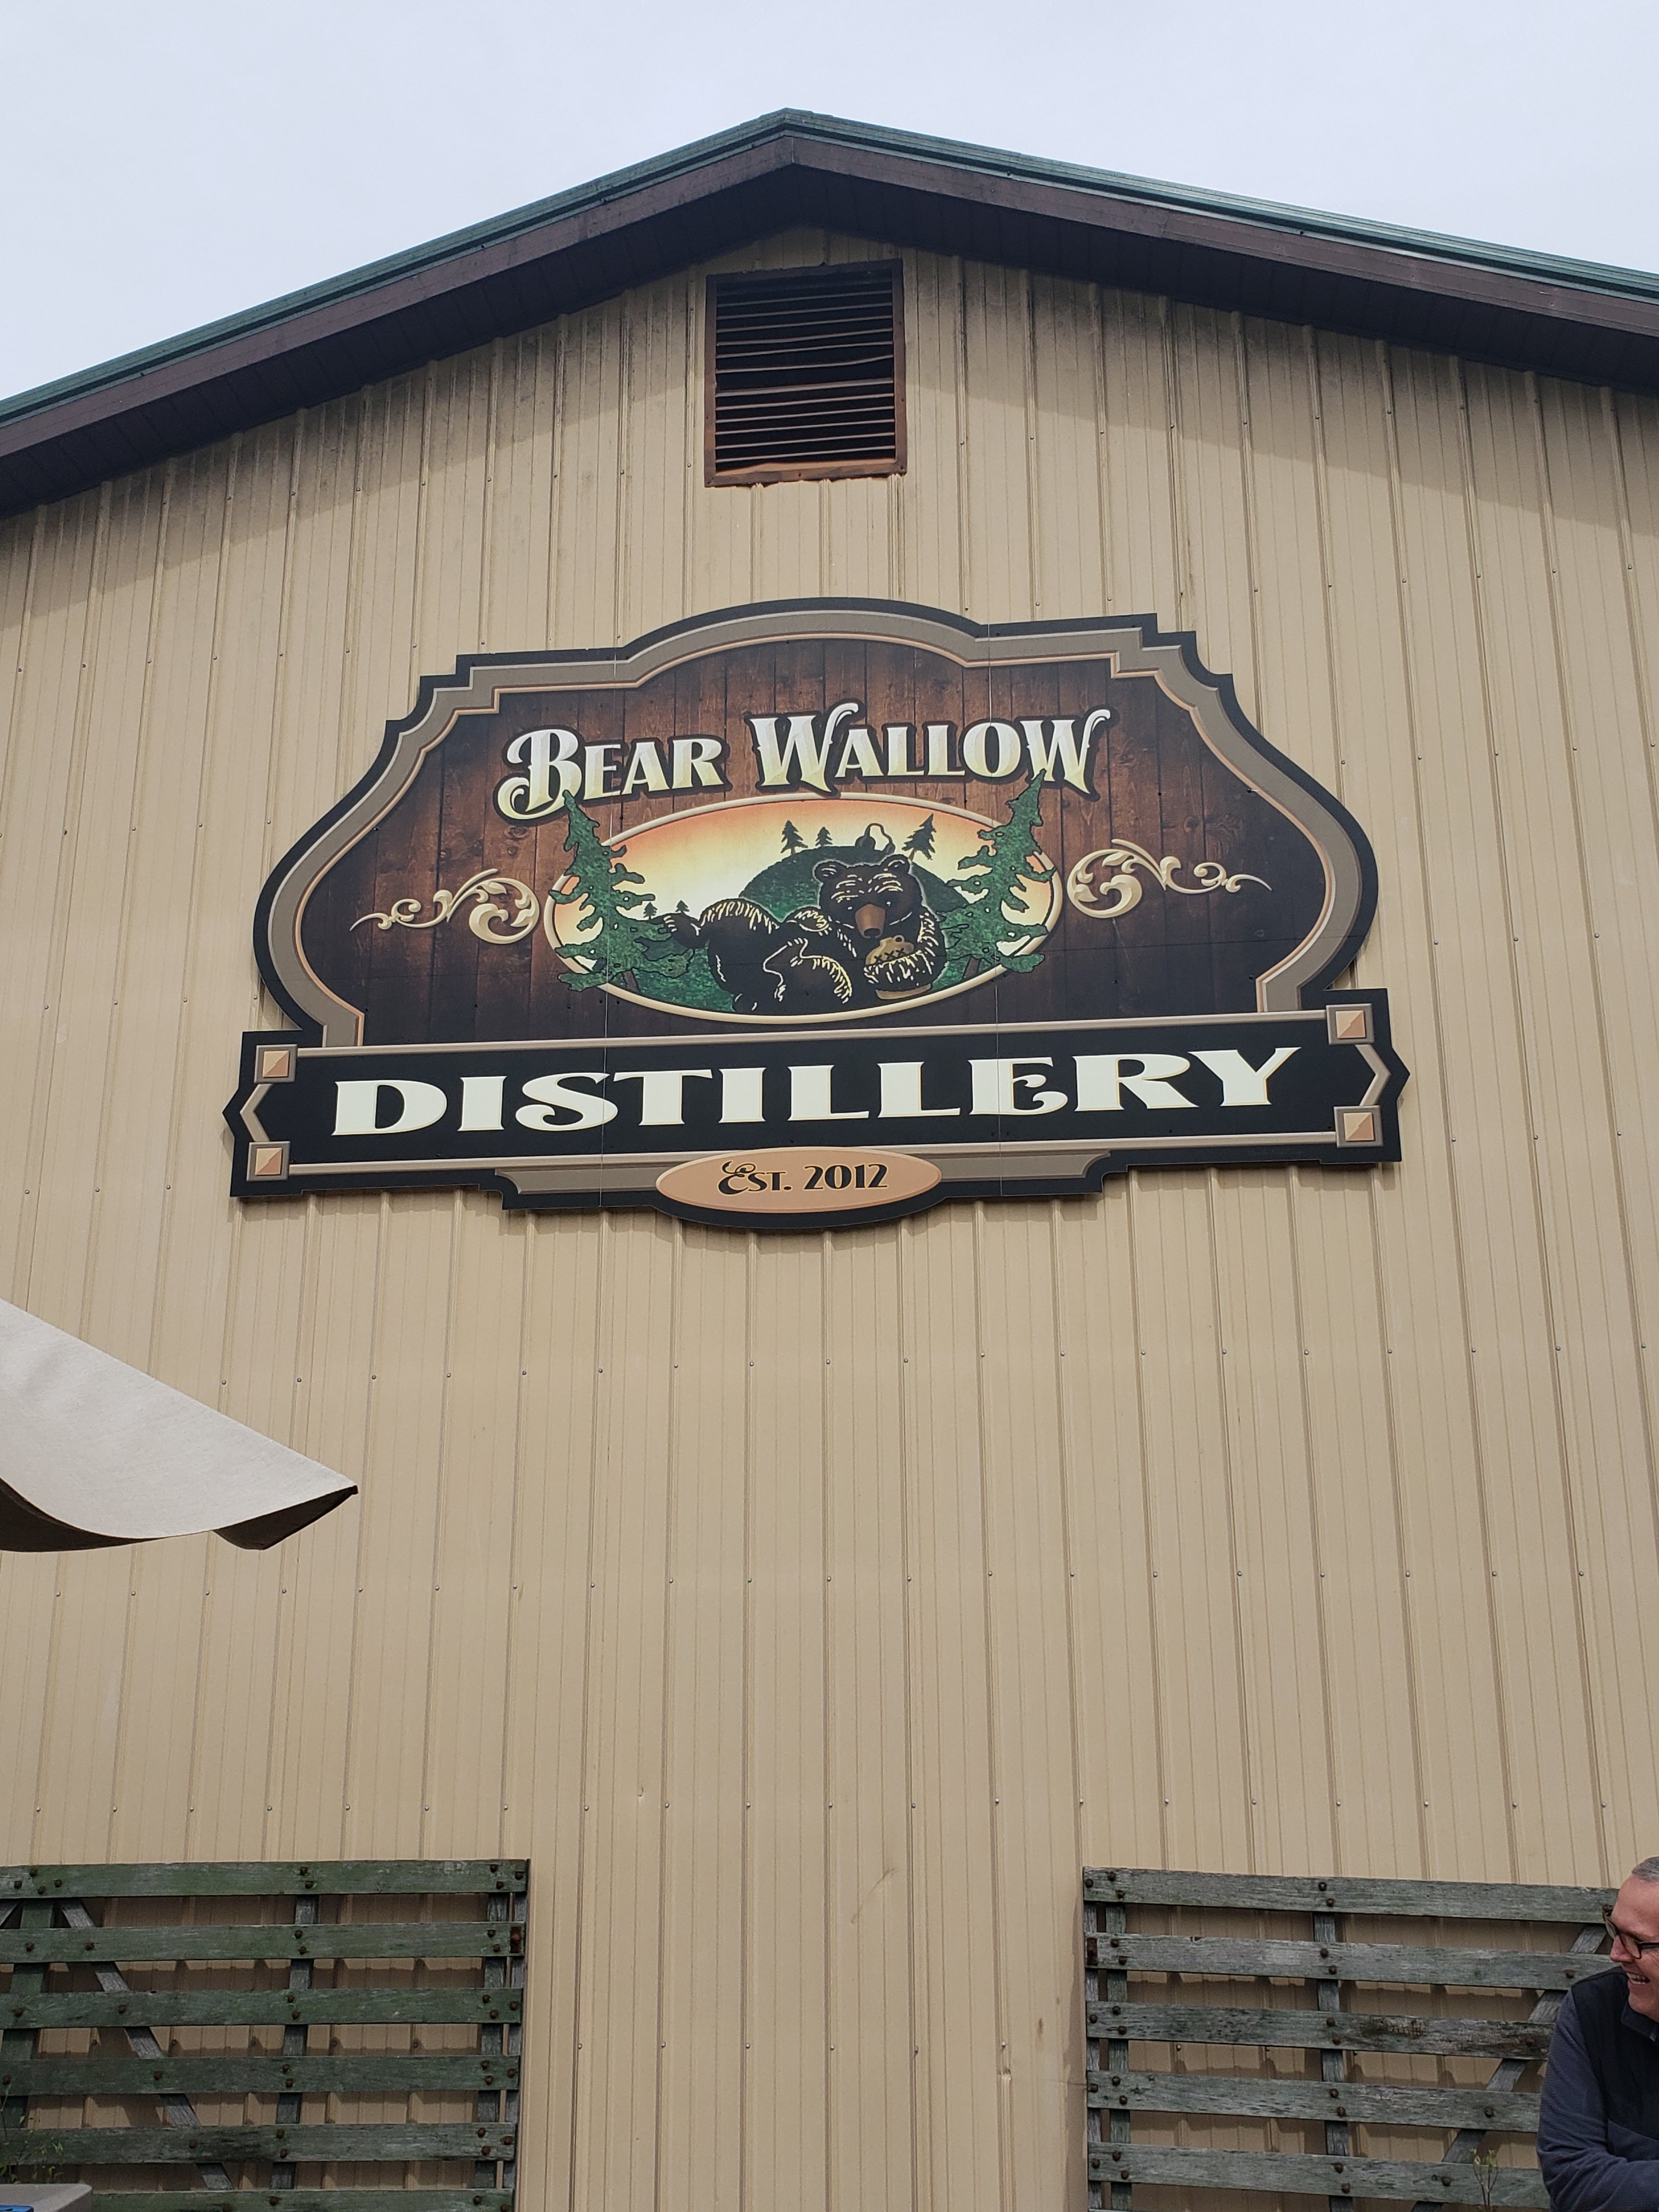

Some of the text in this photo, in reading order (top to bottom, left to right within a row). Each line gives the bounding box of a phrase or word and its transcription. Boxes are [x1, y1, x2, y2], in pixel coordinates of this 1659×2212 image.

[498, 702, 1111, 819] BEAR WALLOW
[331, 1047, 1301, 1135] DISTILLERY
[718, 1161, 888, 1195] EST. 2012
